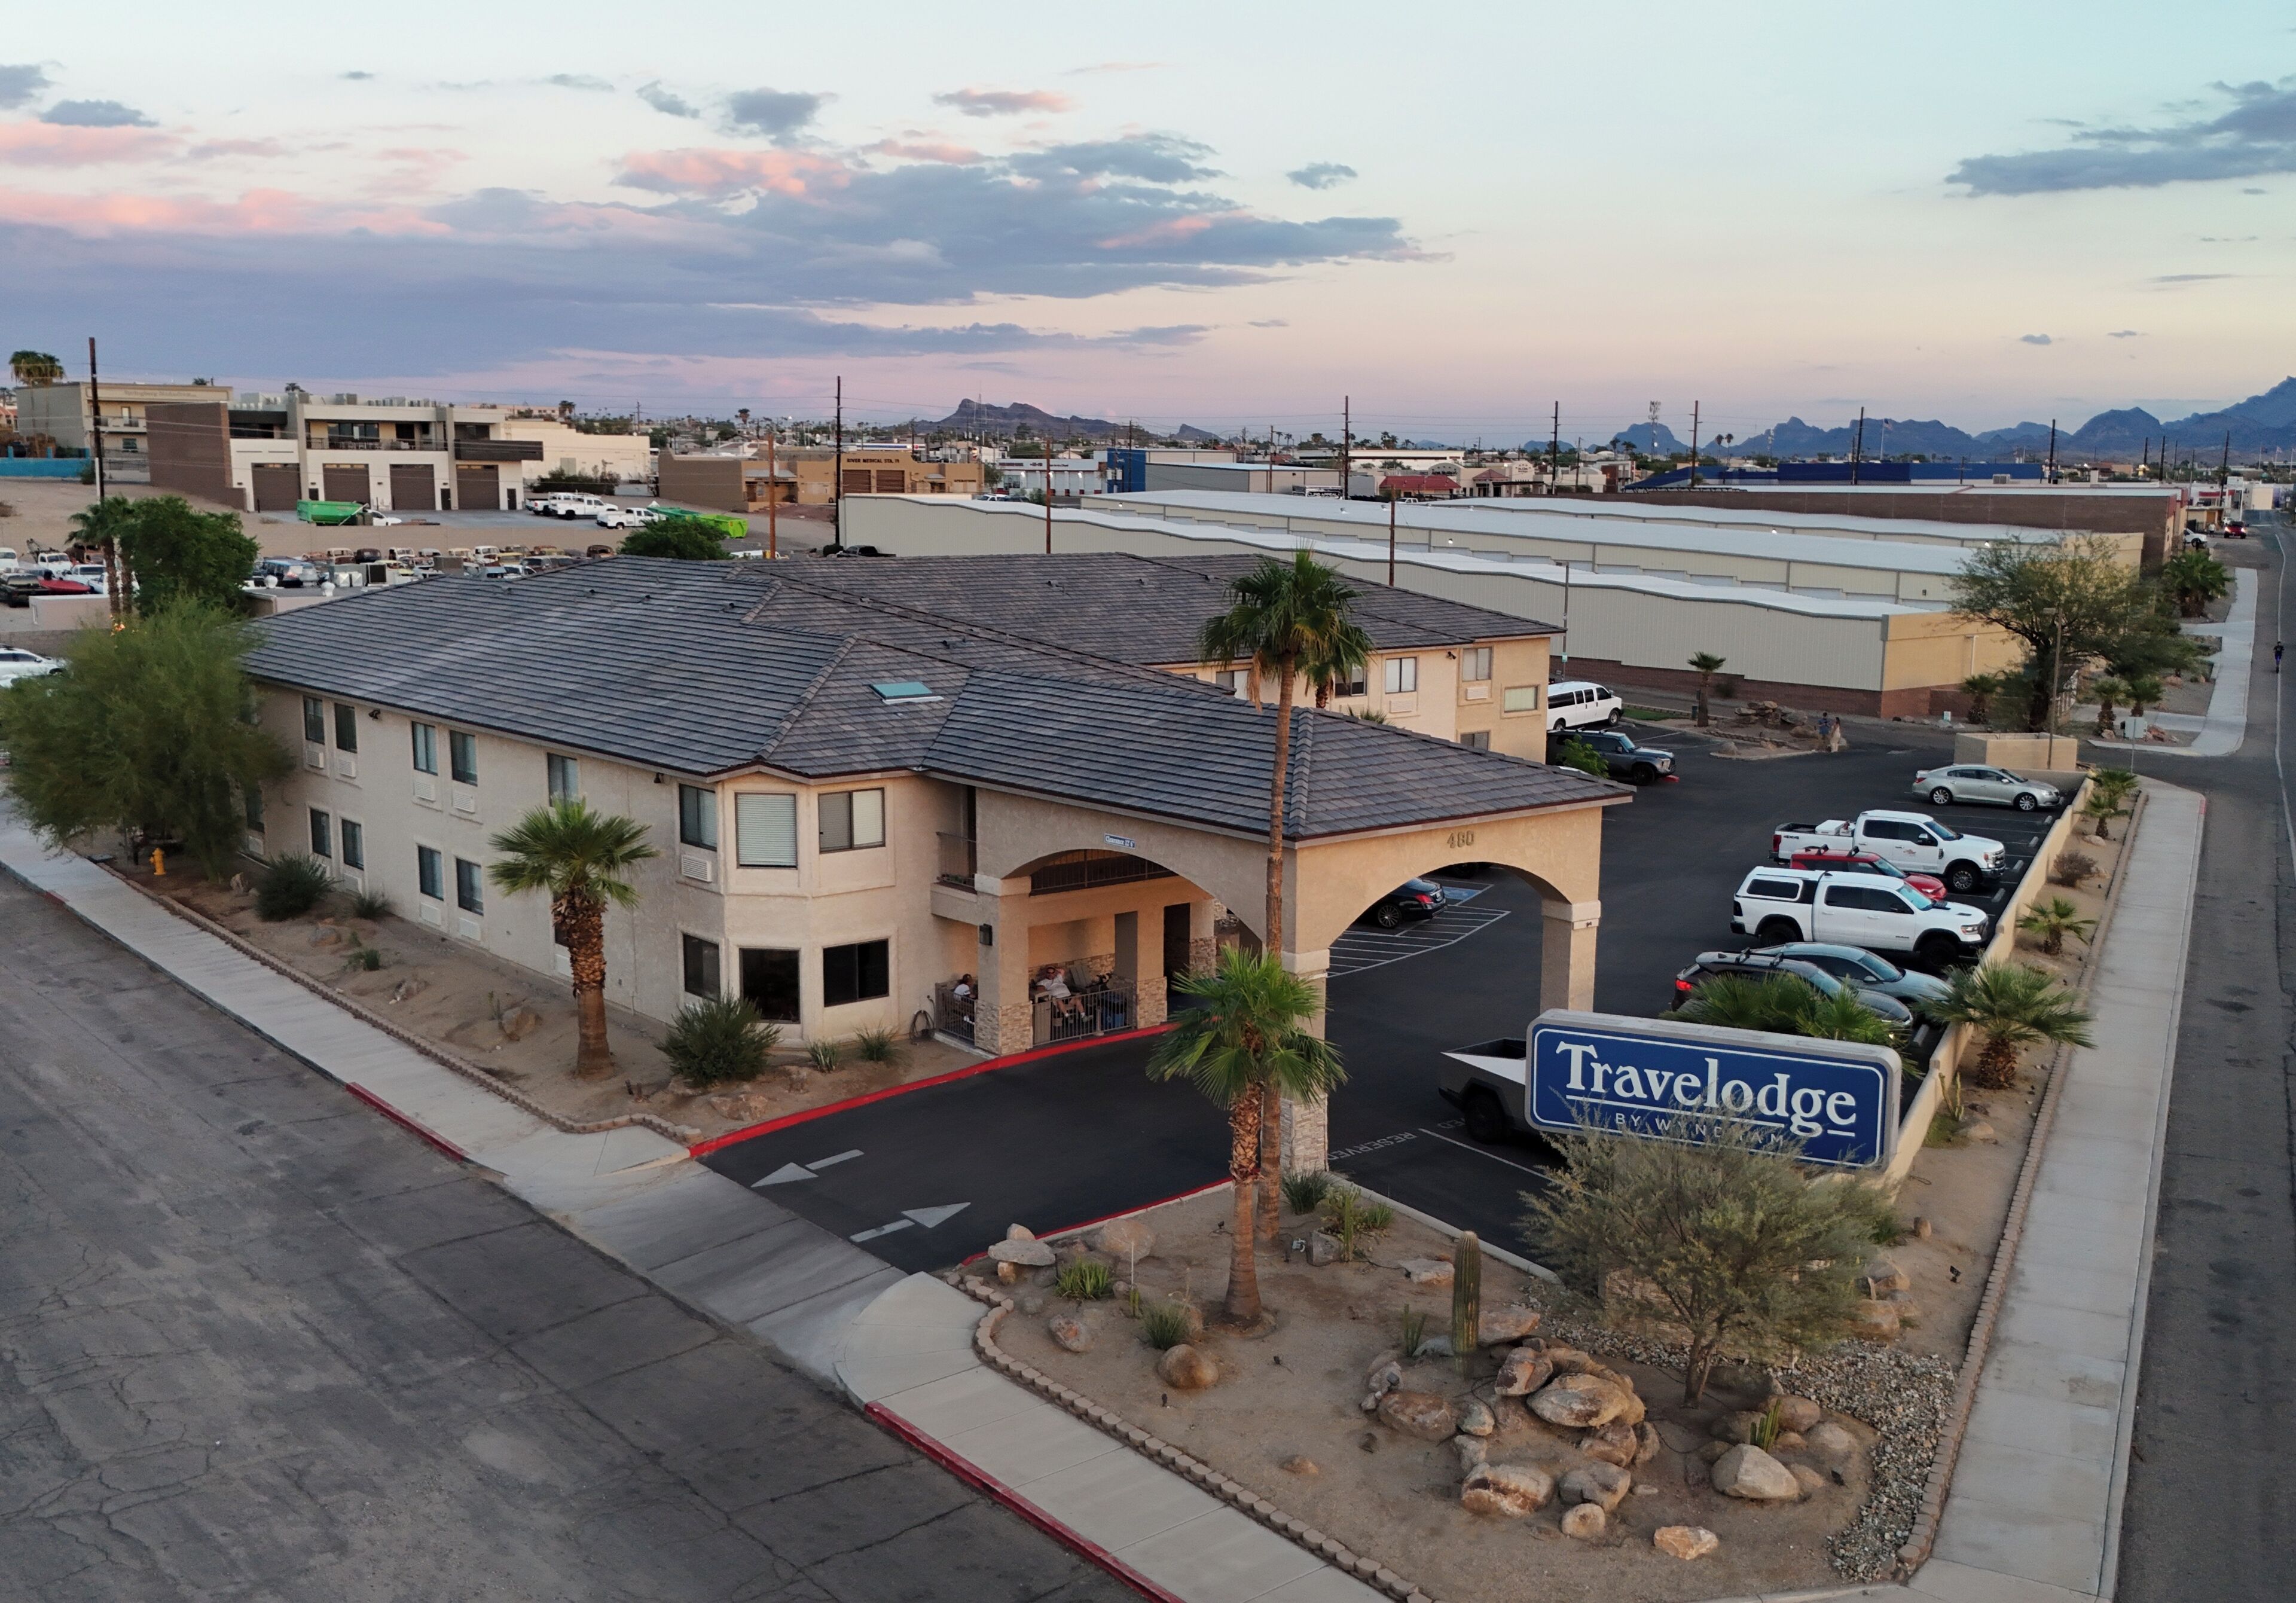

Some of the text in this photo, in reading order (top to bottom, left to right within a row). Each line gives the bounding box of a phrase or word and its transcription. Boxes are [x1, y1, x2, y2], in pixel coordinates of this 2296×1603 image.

[1446, 830, 1474, 848] 480
[1555, 1041, 1857, 1137] Travelodge
[1616, 1113, 1641, 1126] BY
[1327, 1132, 1417, 1160] RESERVED
